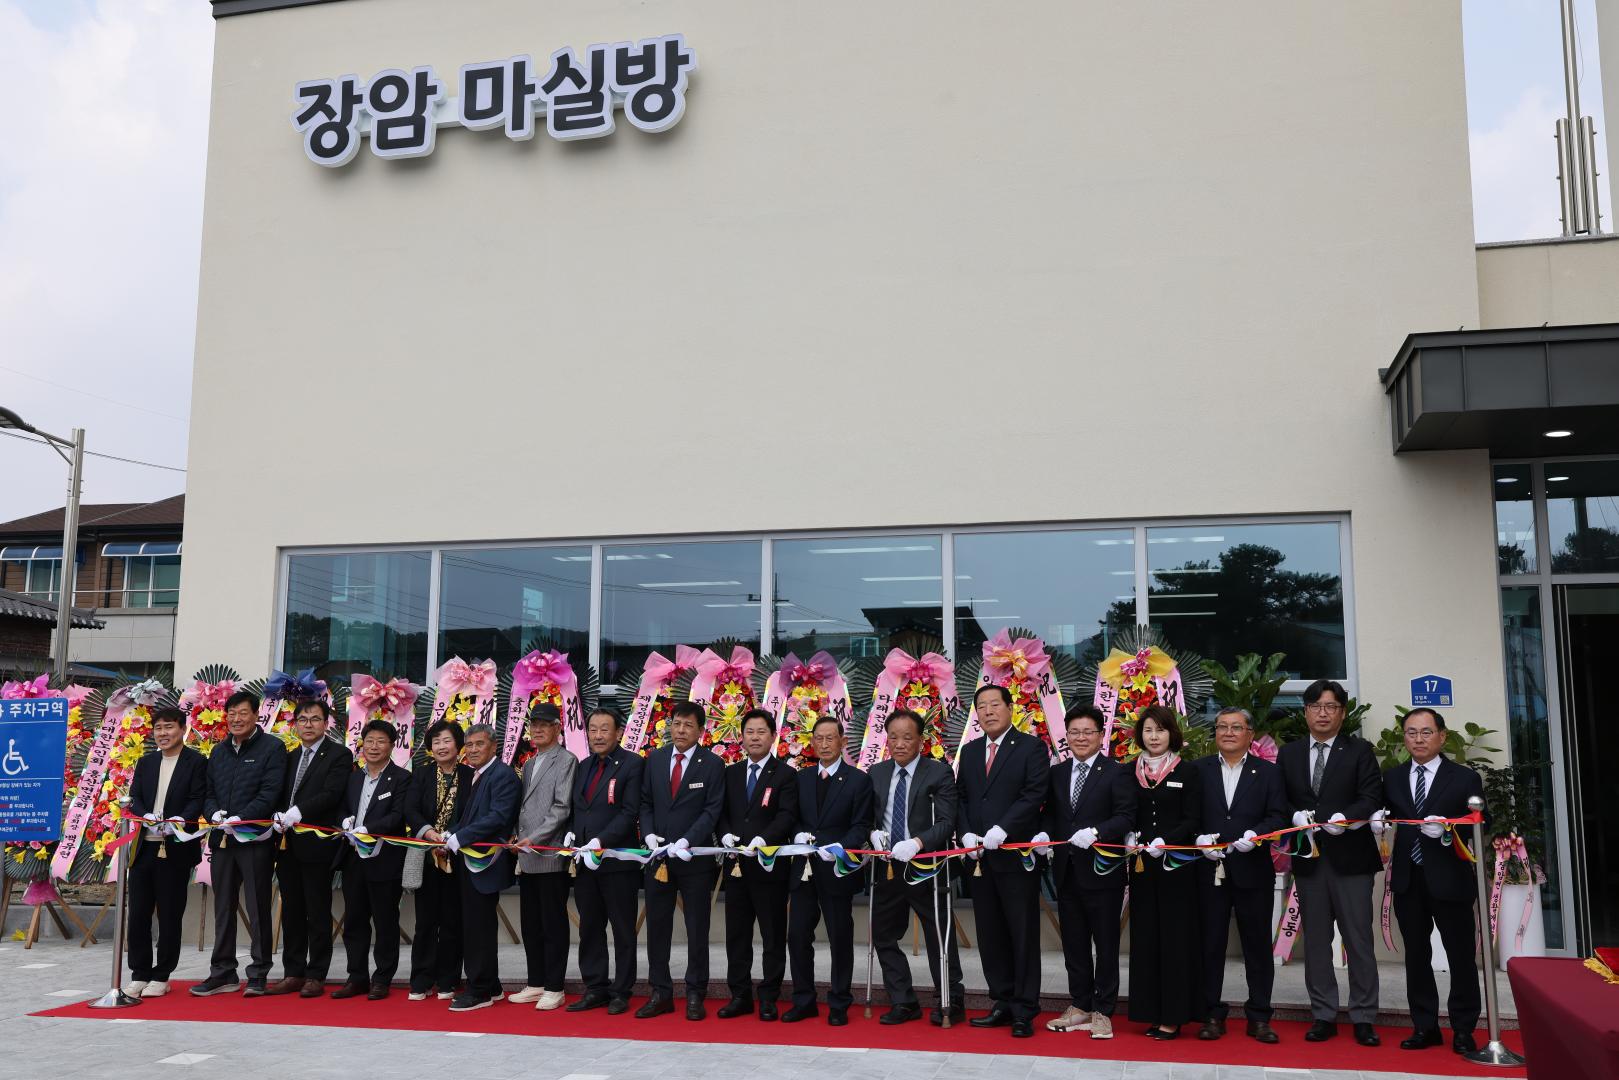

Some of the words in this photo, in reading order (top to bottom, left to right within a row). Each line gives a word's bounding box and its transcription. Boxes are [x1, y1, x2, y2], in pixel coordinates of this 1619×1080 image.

[296, 71, 438, 159] 장암
[463, 38, 690, 132] 마실방
[1425, 680, 1438, 692] 17
[9, 702, 64, 718] 주차구역
